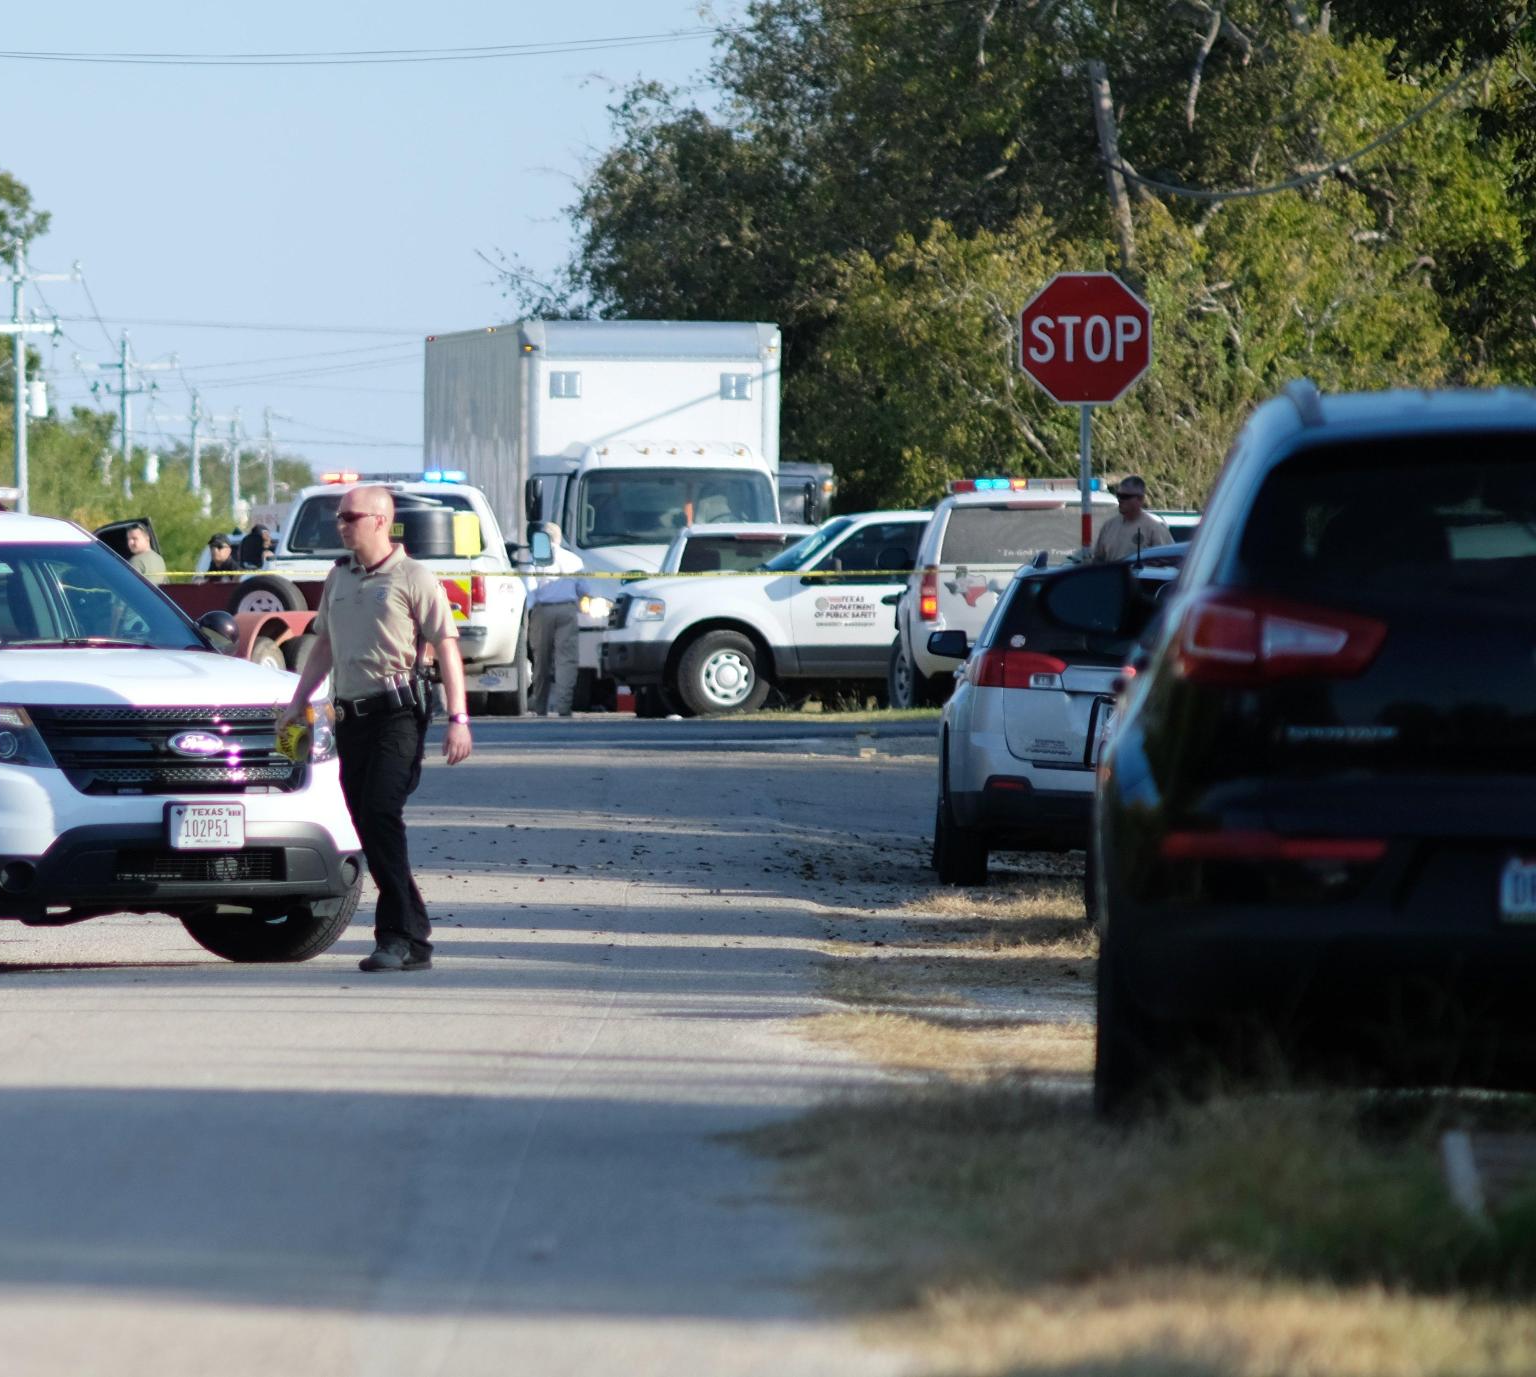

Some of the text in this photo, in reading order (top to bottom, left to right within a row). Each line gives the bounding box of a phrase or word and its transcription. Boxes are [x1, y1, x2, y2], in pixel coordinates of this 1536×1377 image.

[1029, 315, 1142, 363] STOP
[841, 595, 865, 603] TEXAS
[192, 808, 224, 816] TEXAS
[184, 819, 230, 838] 102P51
